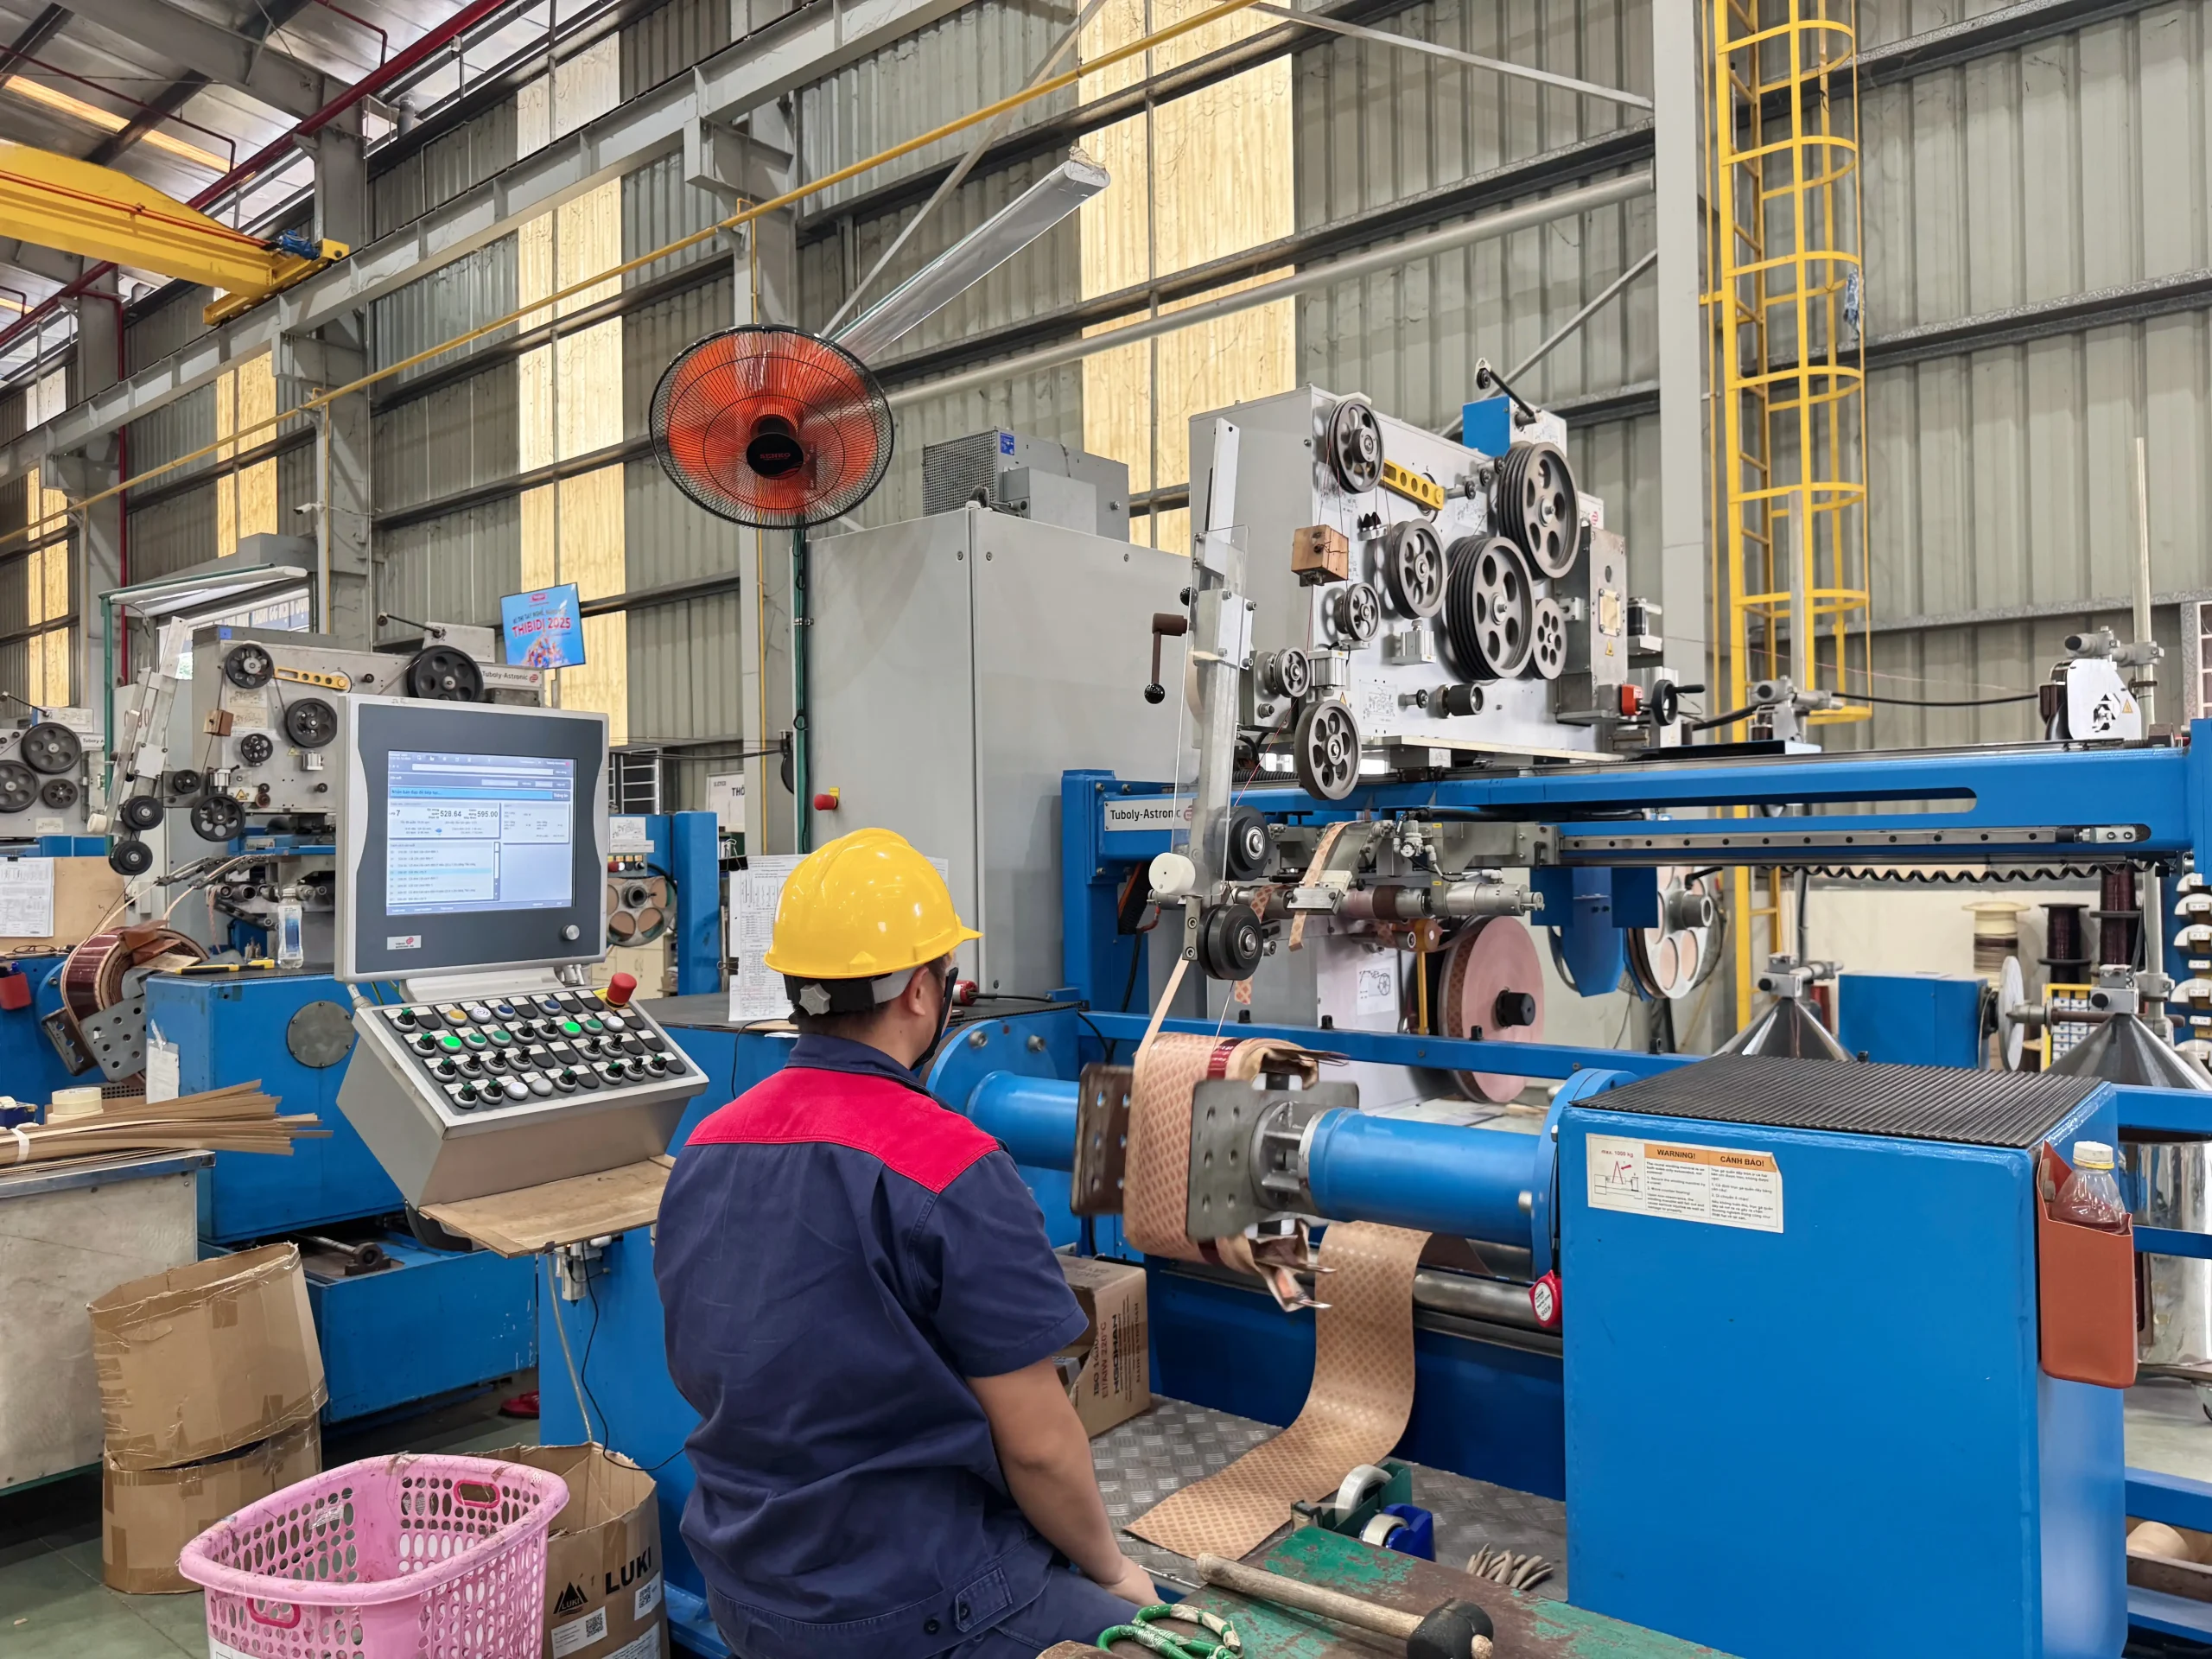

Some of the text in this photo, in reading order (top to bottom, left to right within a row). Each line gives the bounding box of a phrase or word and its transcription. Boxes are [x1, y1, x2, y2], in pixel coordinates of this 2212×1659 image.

[512, 617, 571, 638] THIBIDI 2025
[732, 785, 746, 796] THÔ
[1110, 809, 1181, 822] Tuboly-Astronc
[1657, 1149, 1696, 1160] WARNING!
[606, 1547, 651, 1595] LUKI
[562, 1599, 580, 1610] LUKI
